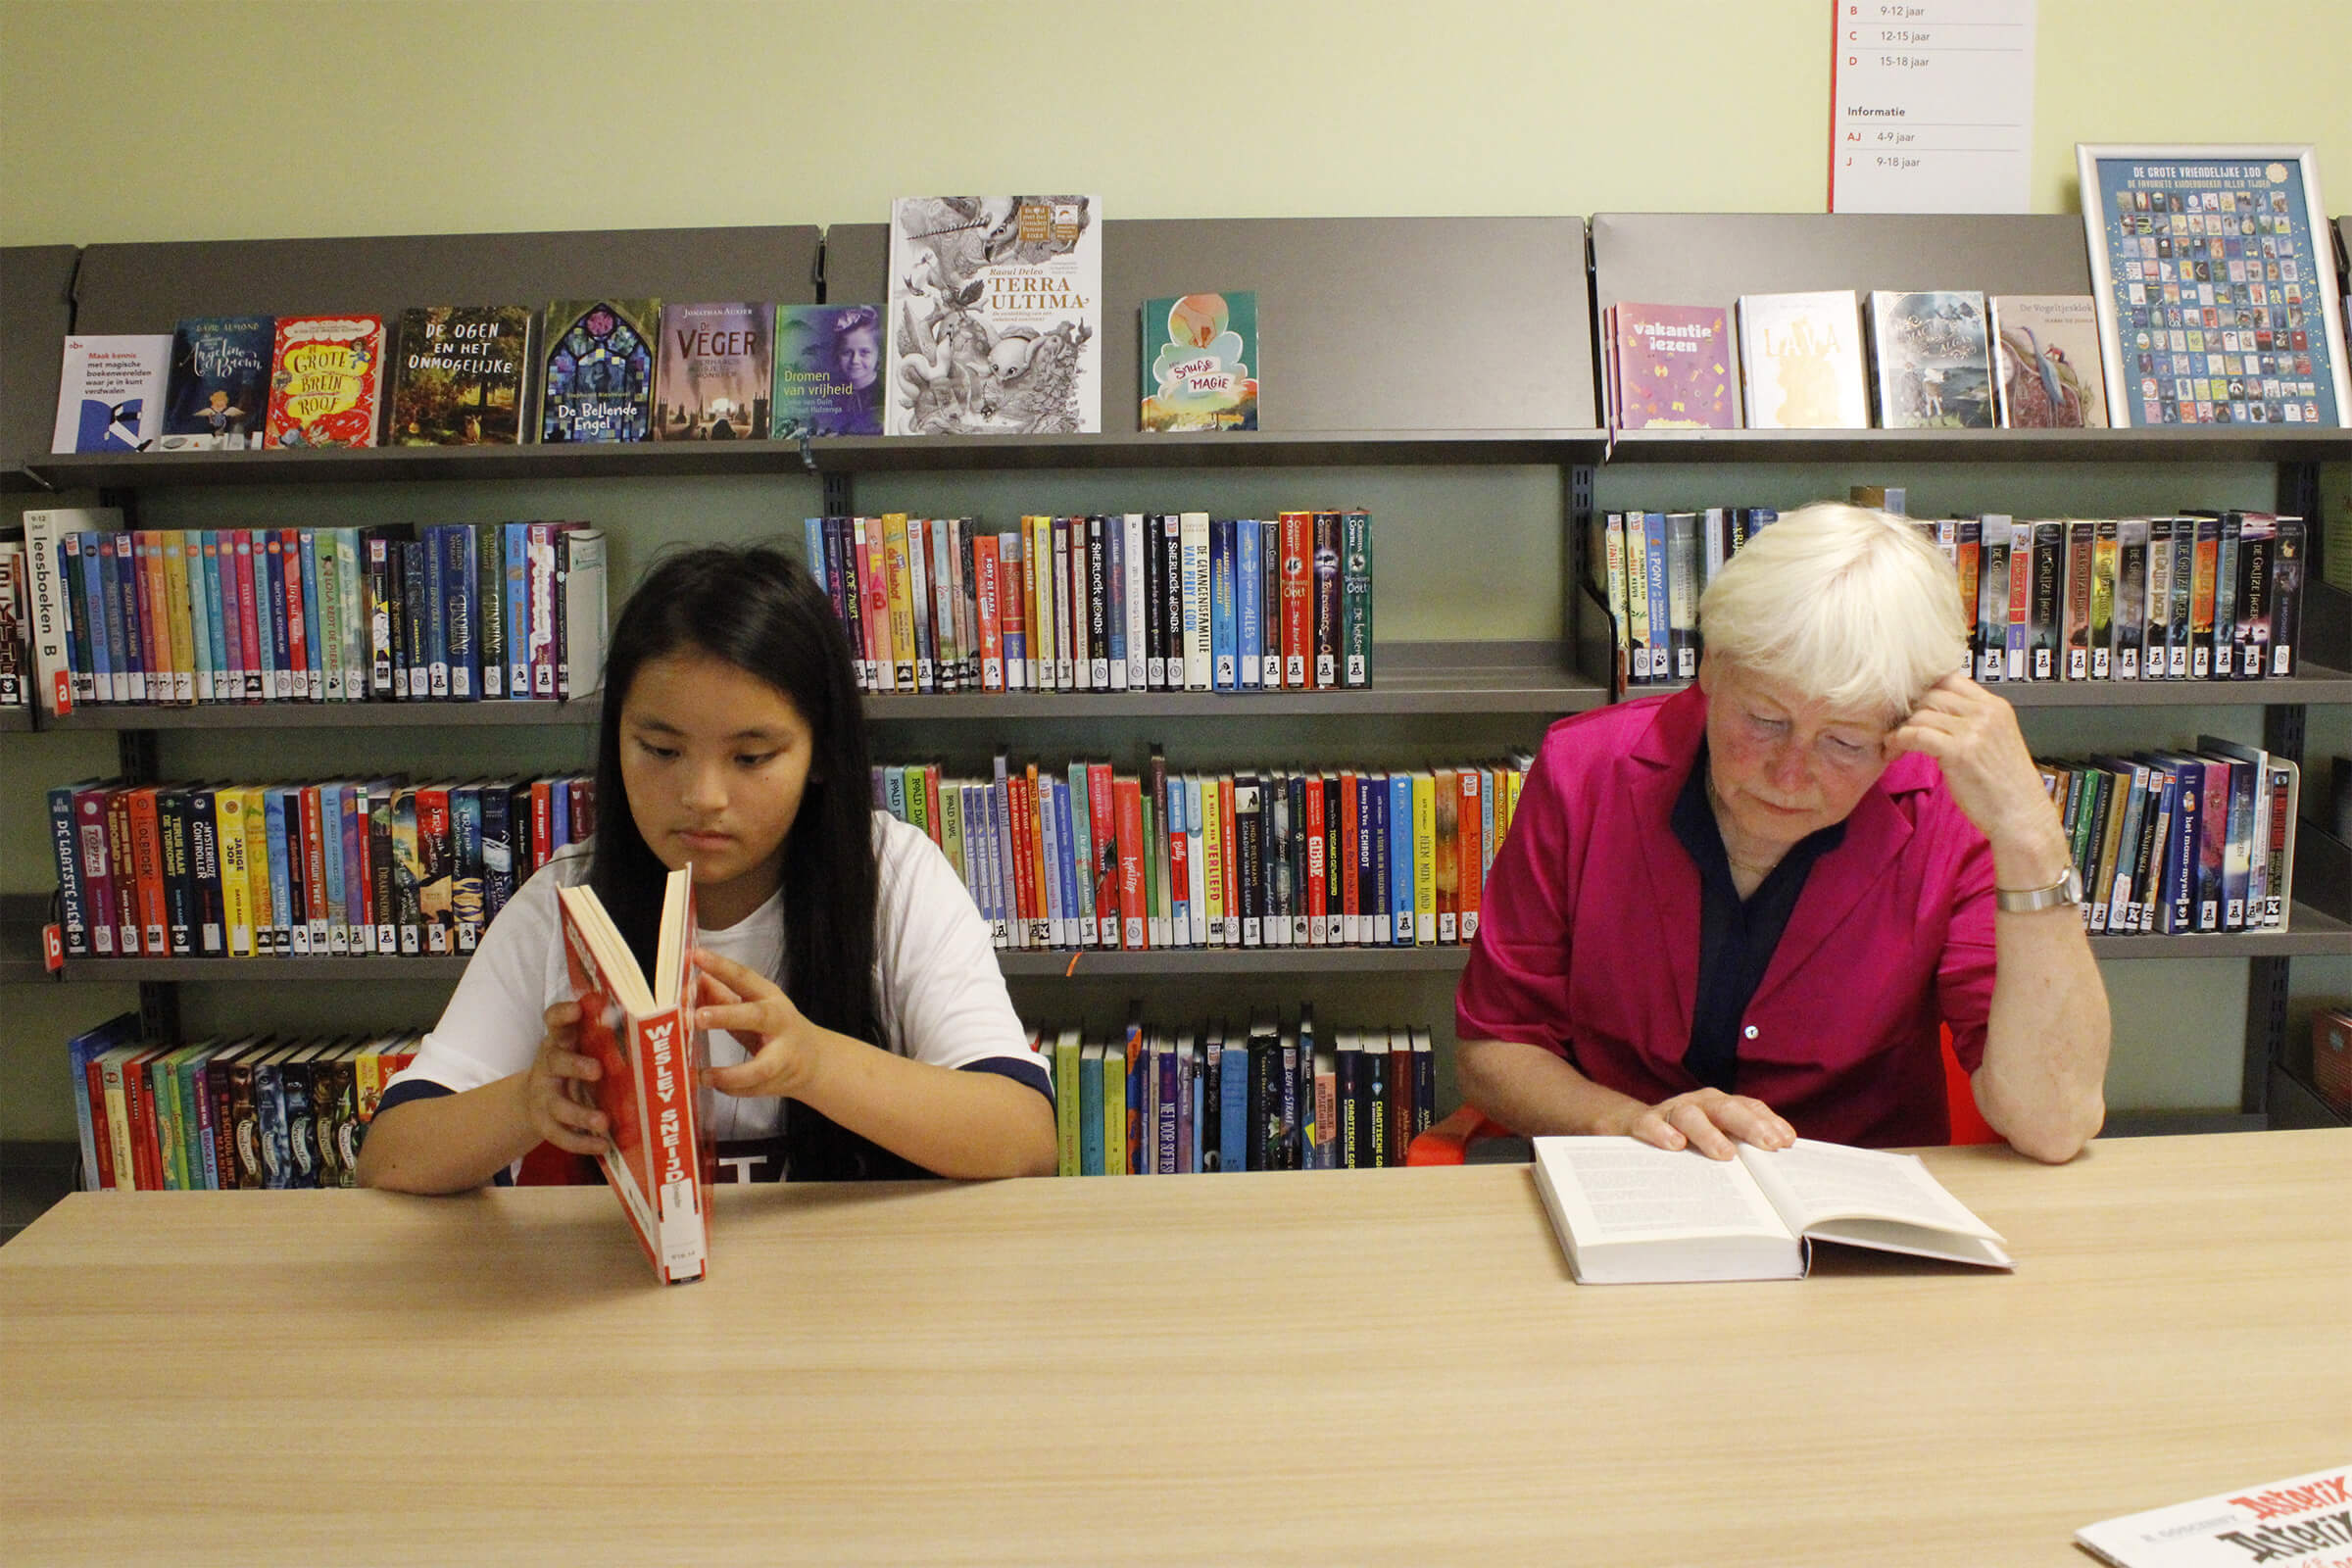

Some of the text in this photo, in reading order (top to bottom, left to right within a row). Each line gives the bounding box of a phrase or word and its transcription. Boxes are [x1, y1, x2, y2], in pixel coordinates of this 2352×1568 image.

[1850, 6, 1924, 18] B 9-12 jaar
[1849, 31, 1930, 43] C 12-15 jaar
[1849, 57, 1929, 69] D 15-18 jaar
[1847, 107, 1905, 117] Informatie
[1847, 132, 1915, 144] AJ 4-9 jaar
[1846, 157, 1920, 170] J 9-18 jaar
[2133, 167, 2261, 177] DE GROTE VRIENDELIJKE 100
[989, 276, 1071, 292] TERRA
[992, 294, 1090, 309] ULTIMA
[425, 322, 499, 339] DE OGEN
[1634, 321, 1712, 339] vakantie
[434, 343, 491, 356] EN HET
[676, 329, 759, 360] VEGER
[1649, 337, 1698, 353] lezen
[294, 354, 347, 373] GROTE
[409, 355, 513, 373] ONMOGELIJKE
[302, 375, 342, 392] BREIN
[784, 370, 830, 381] Dromen
[784, 382, 854, 398] van vrijheid
[558, 405, 576, 417] De
[574, 416, 611, 436] Engel
[1184, 546, 1196, 565] VAN
[2041, 548, 2050, 560] DE
[2253, 544, 2263, 556] DE
[1091, 542, 1102, 595] SHERLOCK
[1168, 542, 1178, 593] SHERLOCK
[1650, 558, 1662, 589] PONY
[1184, 571, 1196, 596] PERRY
[33, 537, 57, 657] leesboeken B
[1197, 546, 1209, 653] DE GEVANGENISFAMILIE
[1185, 609, 1196, 632] COOK
[1245, 607, 1255, 638] ALLES
[58, 683, 69, 703] a
[890, 779, 900, 806] ROALD
[912, 778, 921, 806] ROALD
[2184, 816, 2193, 833] het
[192, 821, 206, 879] CONTROLLER
[204, 826, 216, 878] MYSTERIEUZE
[234, 838, 244, 871] JARIGE
[1172, 840, 1186, 861] Billy
[1309, 836, 1323, 878] GIBBE
[1360, 829, 1369, 868] SCHROOT
[59, 840, 76, 898] LAATSTE
[1207, 844, 1220, 901] VERLIEFD
[645, 1021, 685, 1183] WESLEY SNEIJD
